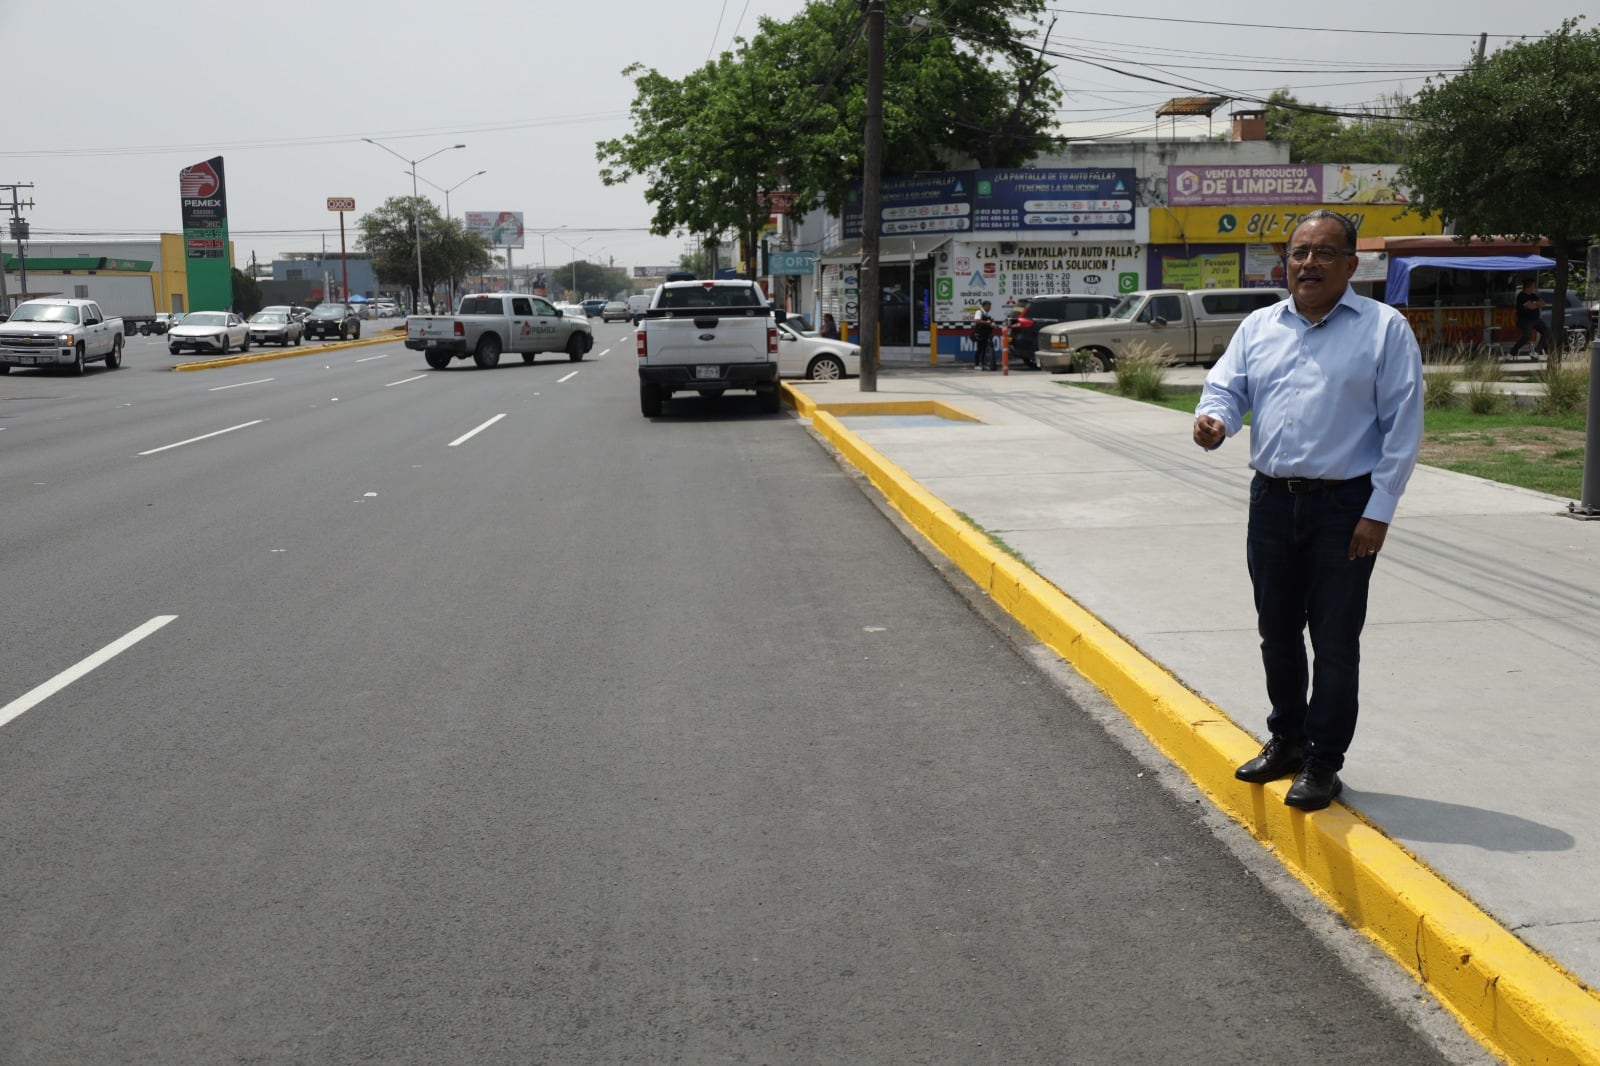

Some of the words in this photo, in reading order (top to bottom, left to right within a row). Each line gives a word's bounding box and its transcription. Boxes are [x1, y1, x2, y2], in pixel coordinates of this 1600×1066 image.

[1009, 172, 1047, 180] PANTALLA
[1048, 172, 1056, 180] DE
[1059, 172, 1068, 180] TU
[1069, 172, 1087, 180] AUTO
[1205, 170, 1236, 178] VENTA
[1238, 169, 1251, 178] DE
[1252, 168, 1308, 178] PRODUCTOS
[1050, 184, 1060, 192] LA
[1202, 180, 1227, 194] DE
[1231, 178, 1317, 194] LIMPIEZA
[184, 199, 221, 207] PEMEX
[328, 199, 353, 208] OXXO
[985, 247, 998, 258] LA
[1018, 247, 1063, 258] PANTALLA
[1068, 246, 1079, 257] TU
[1081, 246, 1103, 257] AUTO
[1006, 259, 1049, 270] TENEMOS
[1052, 259, 1063, 270] LA
[1066, 259, 1108, 270] SOLUCION
[1061, 272, 1070, 280] 20
[531, 326, 556, 334] PEMEX
